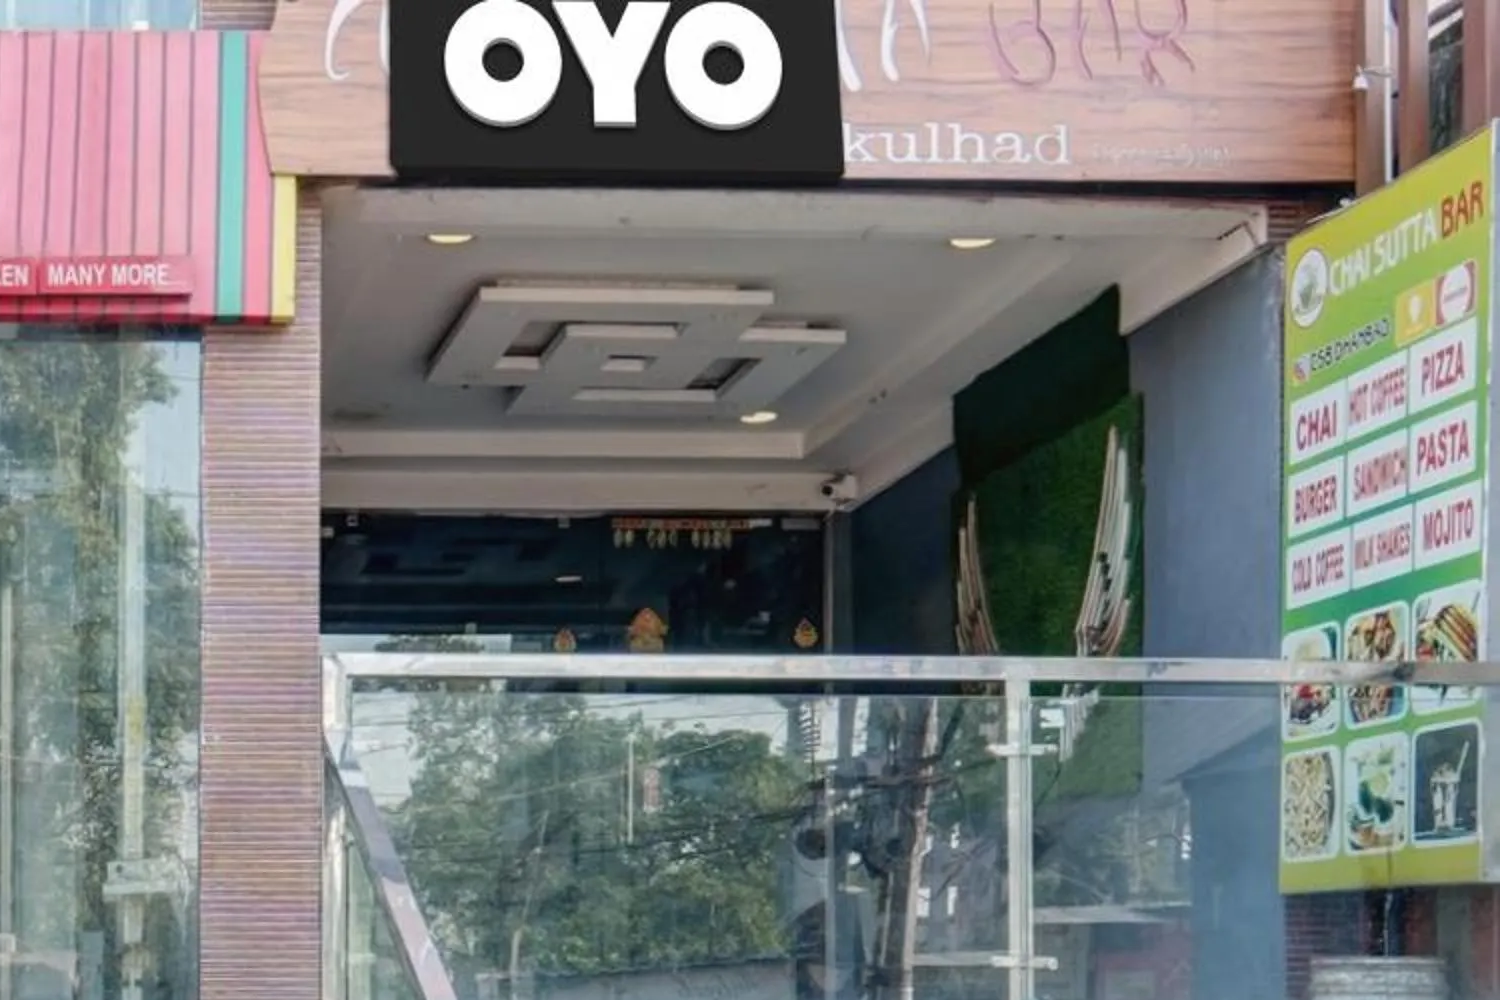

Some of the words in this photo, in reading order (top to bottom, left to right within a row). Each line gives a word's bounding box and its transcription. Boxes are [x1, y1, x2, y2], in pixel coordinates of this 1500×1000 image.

[444, 0, 782, 130] OYO
[844, 122, 1070, 165] kulhad
[1329, 243, 1371, 296] CHAI
[1373, 207, 1438, 275] SUTTA
[1441, 180, 1484, 239] BAR
[48, 263, 105, 286] MANY
[111, 263, 170, 286] MORE
[1371, 368, 1405, 412] COFFEE
[1422, 341, 1465, 395] PIZZA
[1296, 401, 1337, 449] CHAI
[1417, 419, 1469, 476] PASTA
[1295, 475, 1337, 524] BURGER
[1354, 448, 1407, 501] SANDWICH
[1377, 524, 1411, 563] SHAKES
[1423, 498, 1473, 552] MOJITO
[1293, 555, 1312, 594] COLD
[1316, 543, 1345, 587] COFFEE
